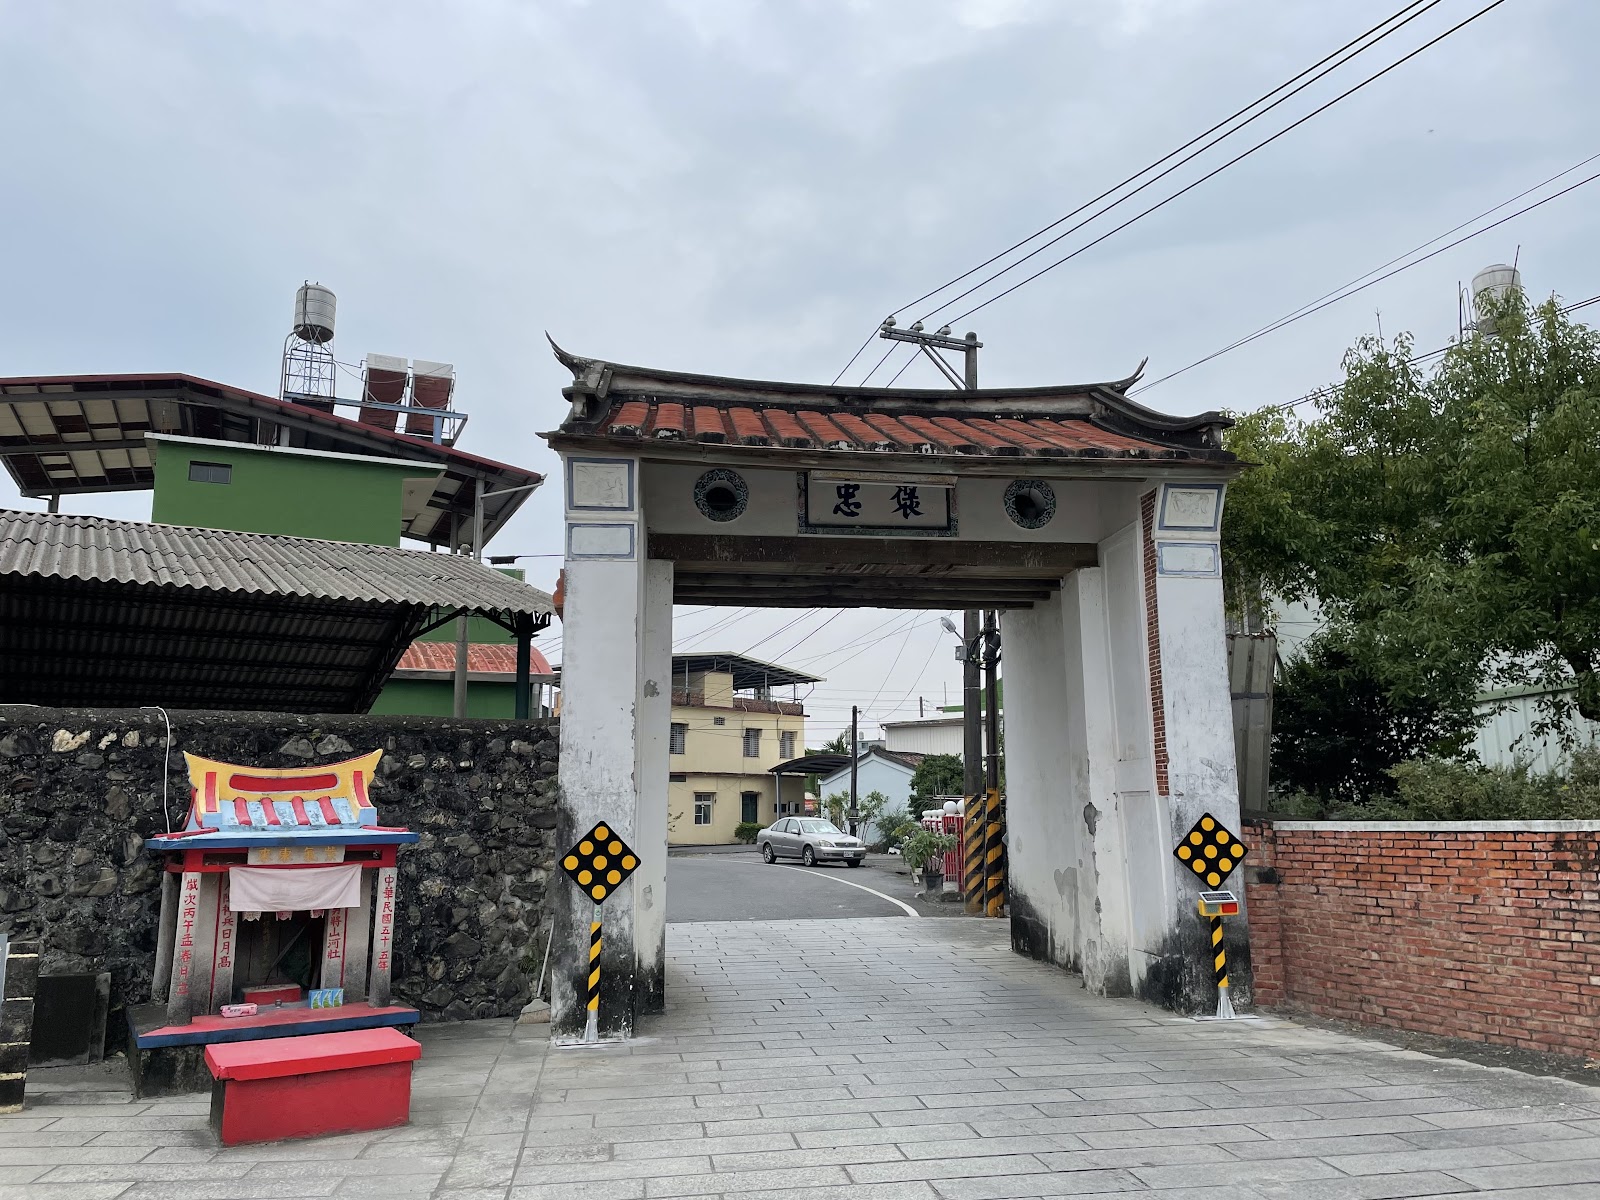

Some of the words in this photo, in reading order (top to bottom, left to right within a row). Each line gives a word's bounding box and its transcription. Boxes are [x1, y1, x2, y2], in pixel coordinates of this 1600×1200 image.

[378, 874, 395, 974] 中華民國五十五年
